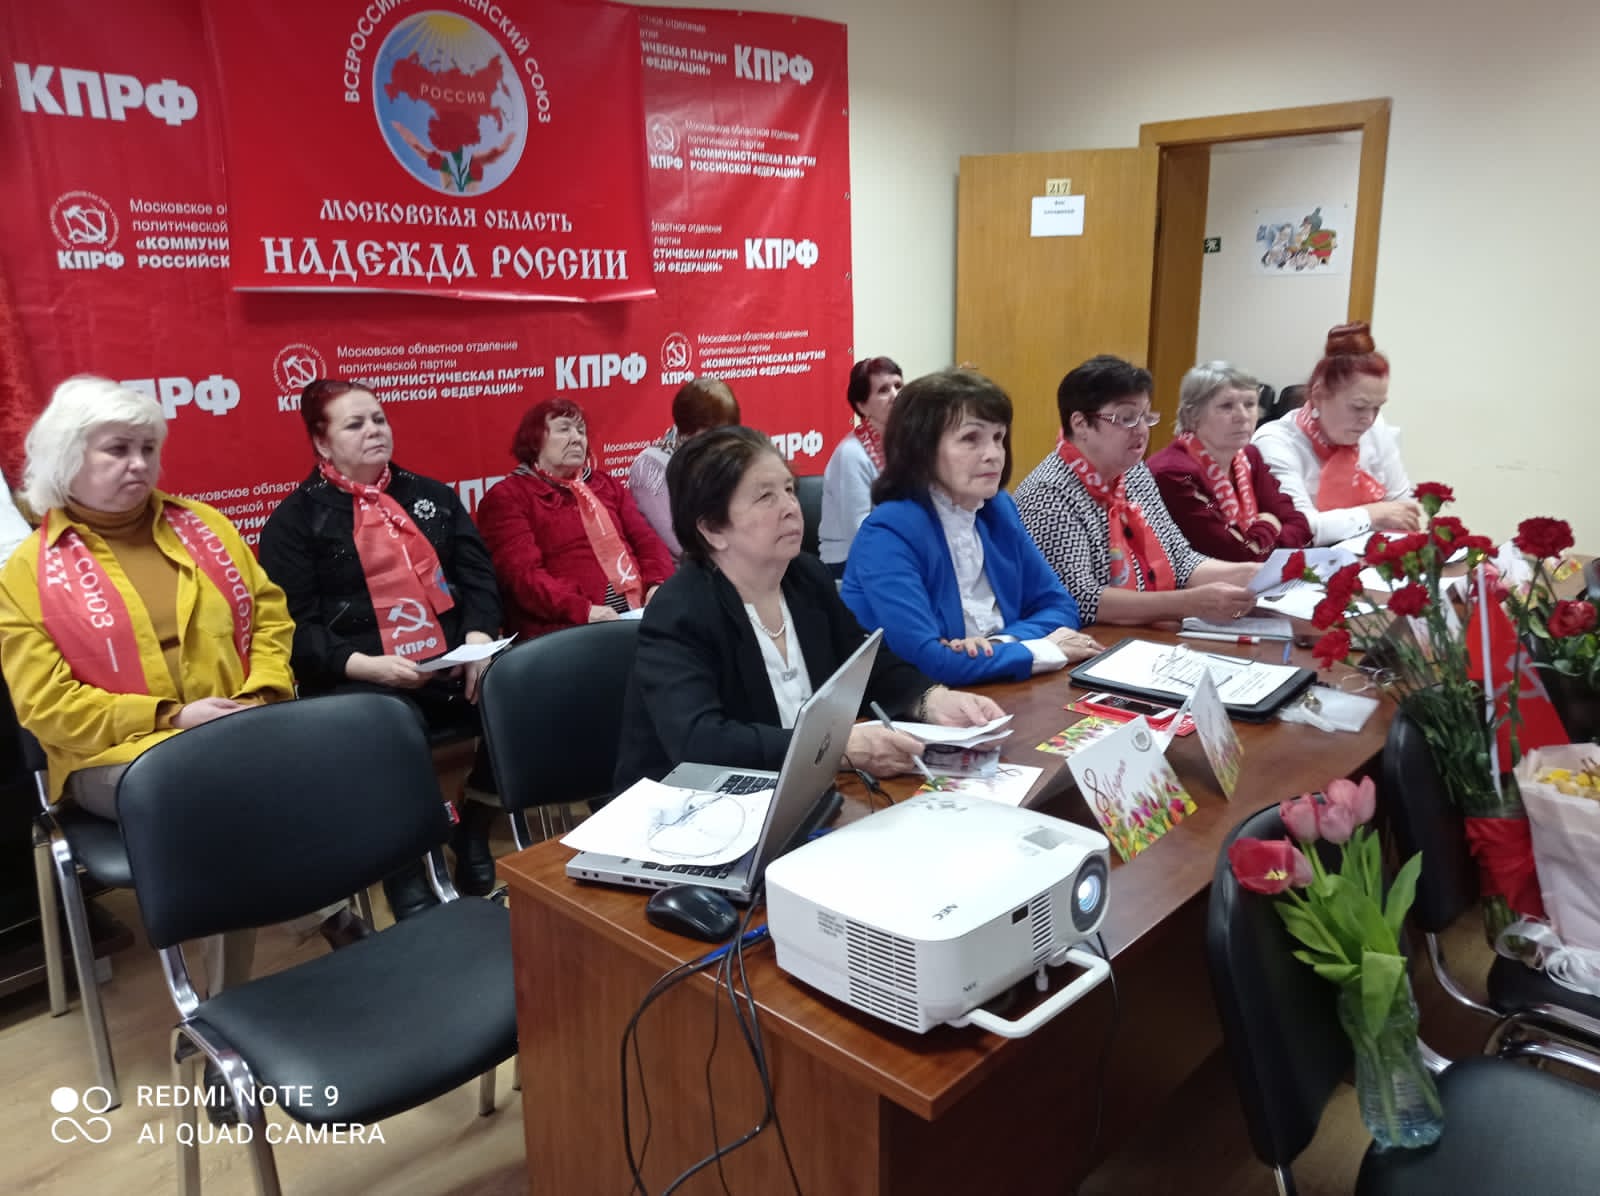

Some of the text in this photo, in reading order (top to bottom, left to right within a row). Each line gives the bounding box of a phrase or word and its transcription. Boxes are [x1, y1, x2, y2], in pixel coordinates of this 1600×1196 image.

[458, 0, 530, 56] ЕНСКИЙ
[525, 57, 551, 123] СОЮЗ
[690, 48, 727, 65] ПАРТИЯ
[734, 44, 814, 85] КПРФ
[14, 62, 198, 126] КПРФ
[420, 83, 486, 104] РОССИЯ
[650, 155, 684, 170] КПРФ
[690, 160, 751, 175] РОССИЙСКОЙ
[1049, 183, 1069, 193] 217
[130, 198, 213, 215] Московское
[319, 199, 574, 233] МОСКОВСКАЯ ОБЛАСТЬ
[132, 220, 228, 233] политической
[57, 250, 125, 270] КПРФ
[260, 236, 629, 285] НАДЕЖДА РОССИИ
[706, 248, 738, 260] ПАРТИЯ
[745, 238, 819, 270] КПРФ
[337, 340, 518, 358] Московское областное отделение
[795, 349, 826, 362] ПАРТИЯ
[339, 358, 457, 374] политической партии
[498, 366, 545, 380] ПАРТИЯ
[555, 351, 648, 391] КПРФ
[661, 370, 696, 386] КПРФ
[376, 382, 524, 403] ИЙСКОЙ ФЕДЕРАЦИИ»
[770, 429, 824, 461] ПРФ
[394, 636, 437, 657] КПРФ
